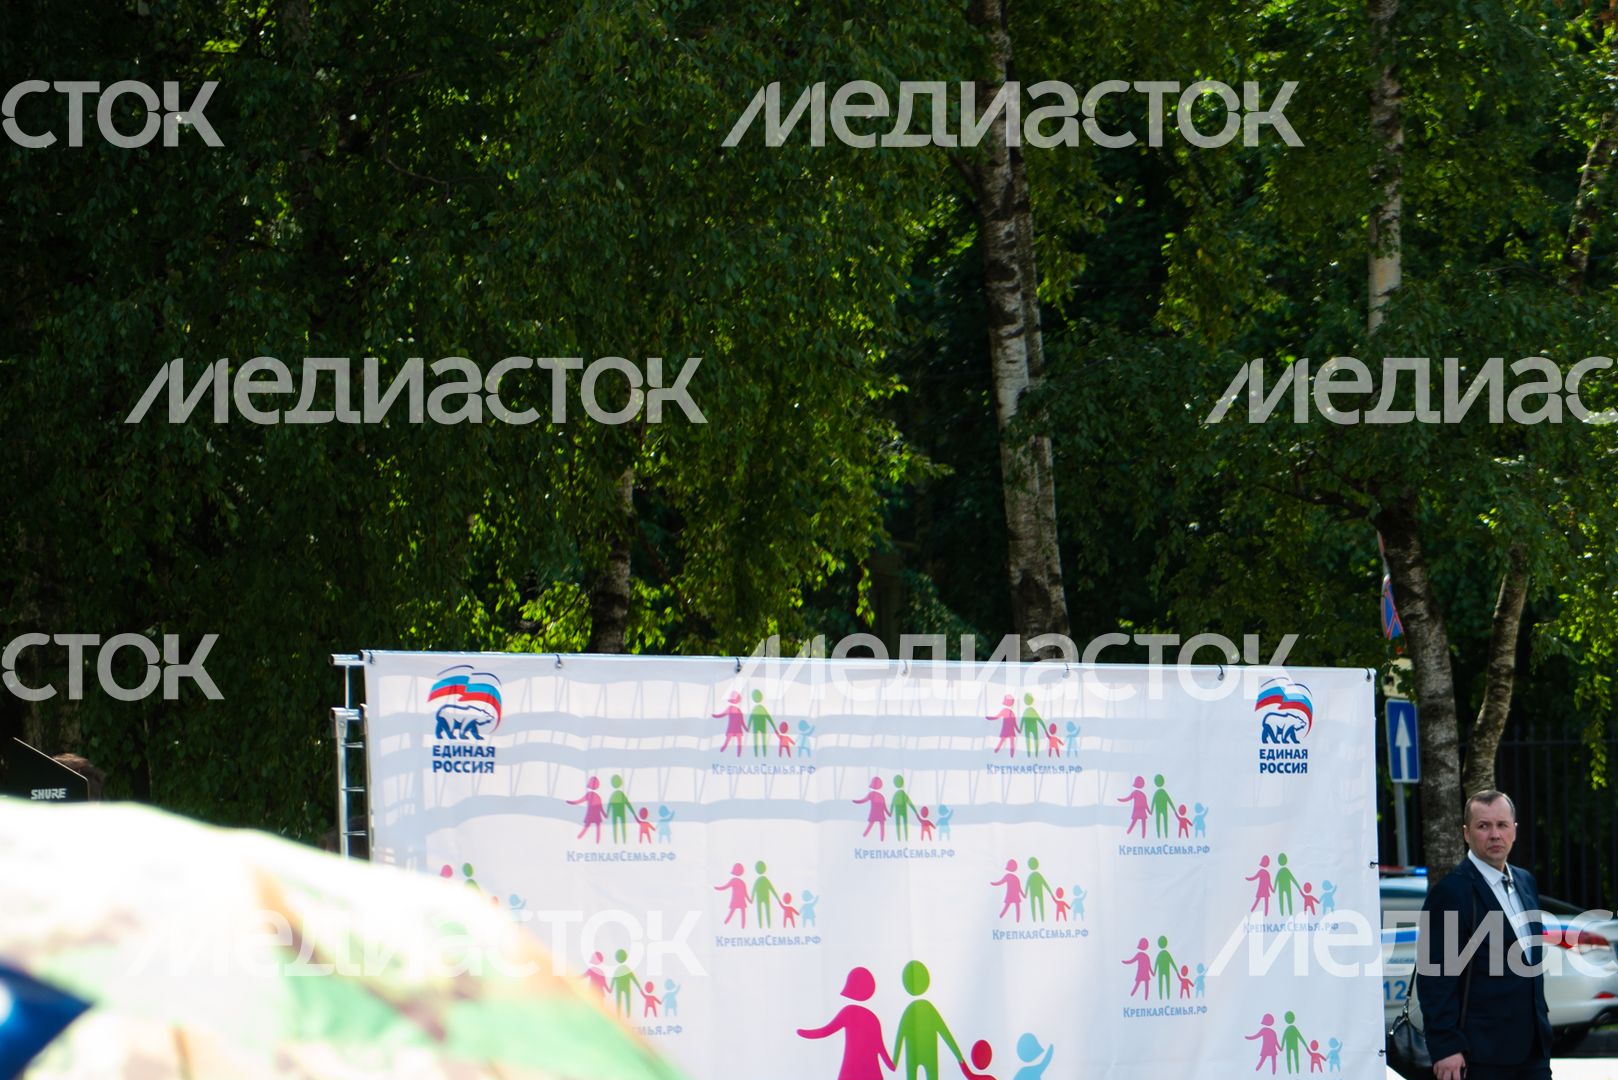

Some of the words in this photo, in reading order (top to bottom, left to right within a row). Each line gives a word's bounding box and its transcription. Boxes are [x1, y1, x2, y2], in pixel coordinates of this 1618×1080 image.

[432, 745, 496, 758] ЕДИНАЯ
[1259, 748, 1308, 760] ЕДИНАЯ
[432, 760, 494, 774] РОССИЯ
[1259, 762, 1308, 774] РОССИЯ
[30, 787, 68, 800] SHURE
